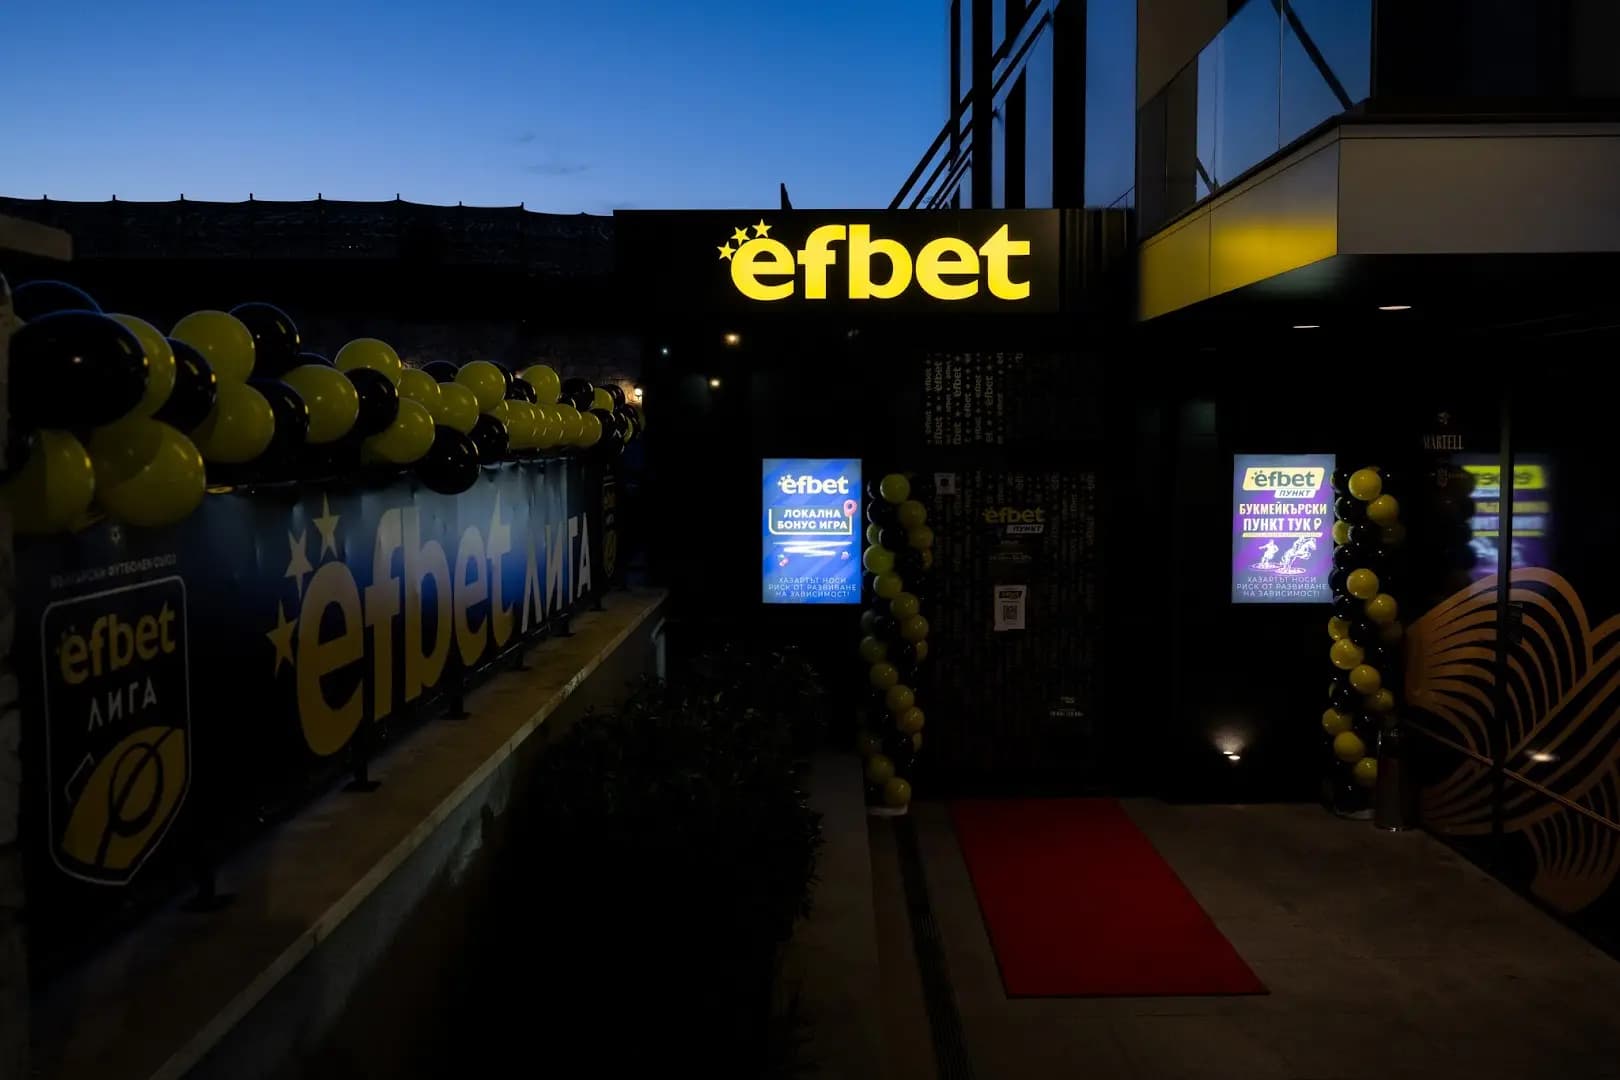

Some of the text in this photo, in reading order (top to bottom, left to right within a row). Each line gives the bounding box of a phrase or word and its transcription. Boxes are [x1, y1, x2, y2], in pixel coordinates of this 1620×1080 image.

[730, 223, 1031, 301] efbet
[780, 475, 849, 494] efbet
[1254, 471, 1316, 487] efbet
[1279, 489, 1312, 497] ПУНКТ
[784, 509, 842, 519] ЛОКАЛНА
[984, 506, 1046, 524] efbet
[1239, 502, 1327, 515] БУКМЕЙКЪРСКИ
[777, 520, 848, 529] БОНУС ИГРА
[1243, 518, 1311, 531] ПУНКТ ТУК
[296, 497, 593, 758] efbet ЛИГА
[57, 600, 177, 688] efbet
[87, 676, 159, 735] ЛИГА
